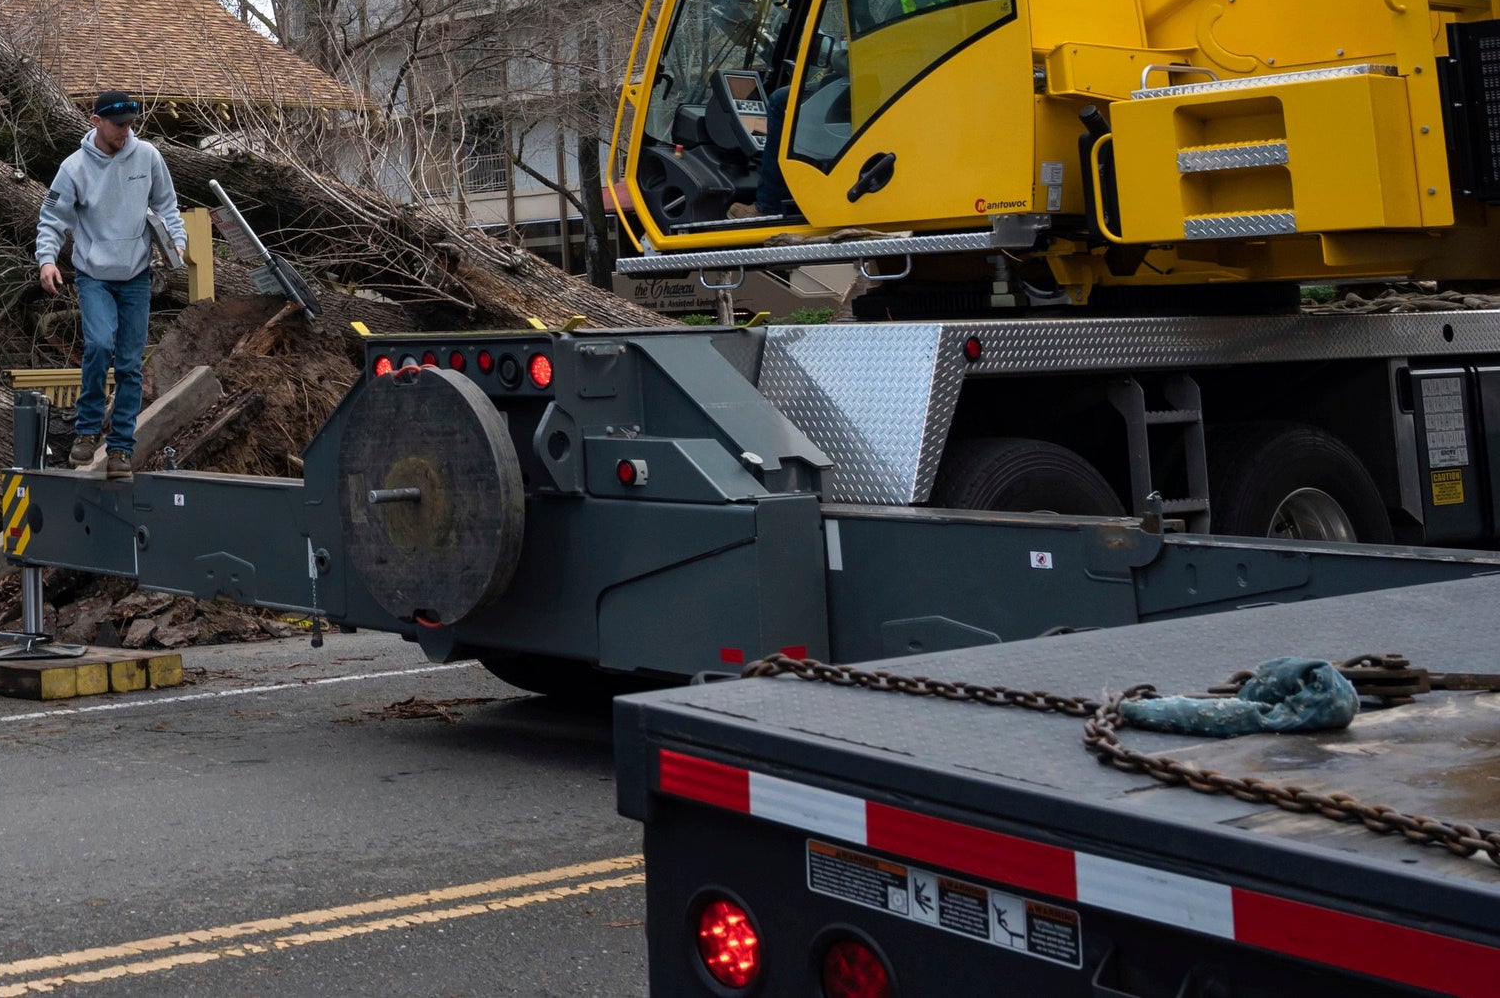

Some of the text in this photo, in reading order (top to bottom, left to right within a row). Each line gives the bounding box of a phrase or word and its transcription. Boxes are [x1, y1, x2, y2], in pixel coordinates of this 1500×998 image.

[974, 198, 1027, 213] Manitowoc
[634, 279, 695, 299] the Chateau
[668, 300, 694, 308] Assisted
[1433, 472, 1460, 482] CAUTION
